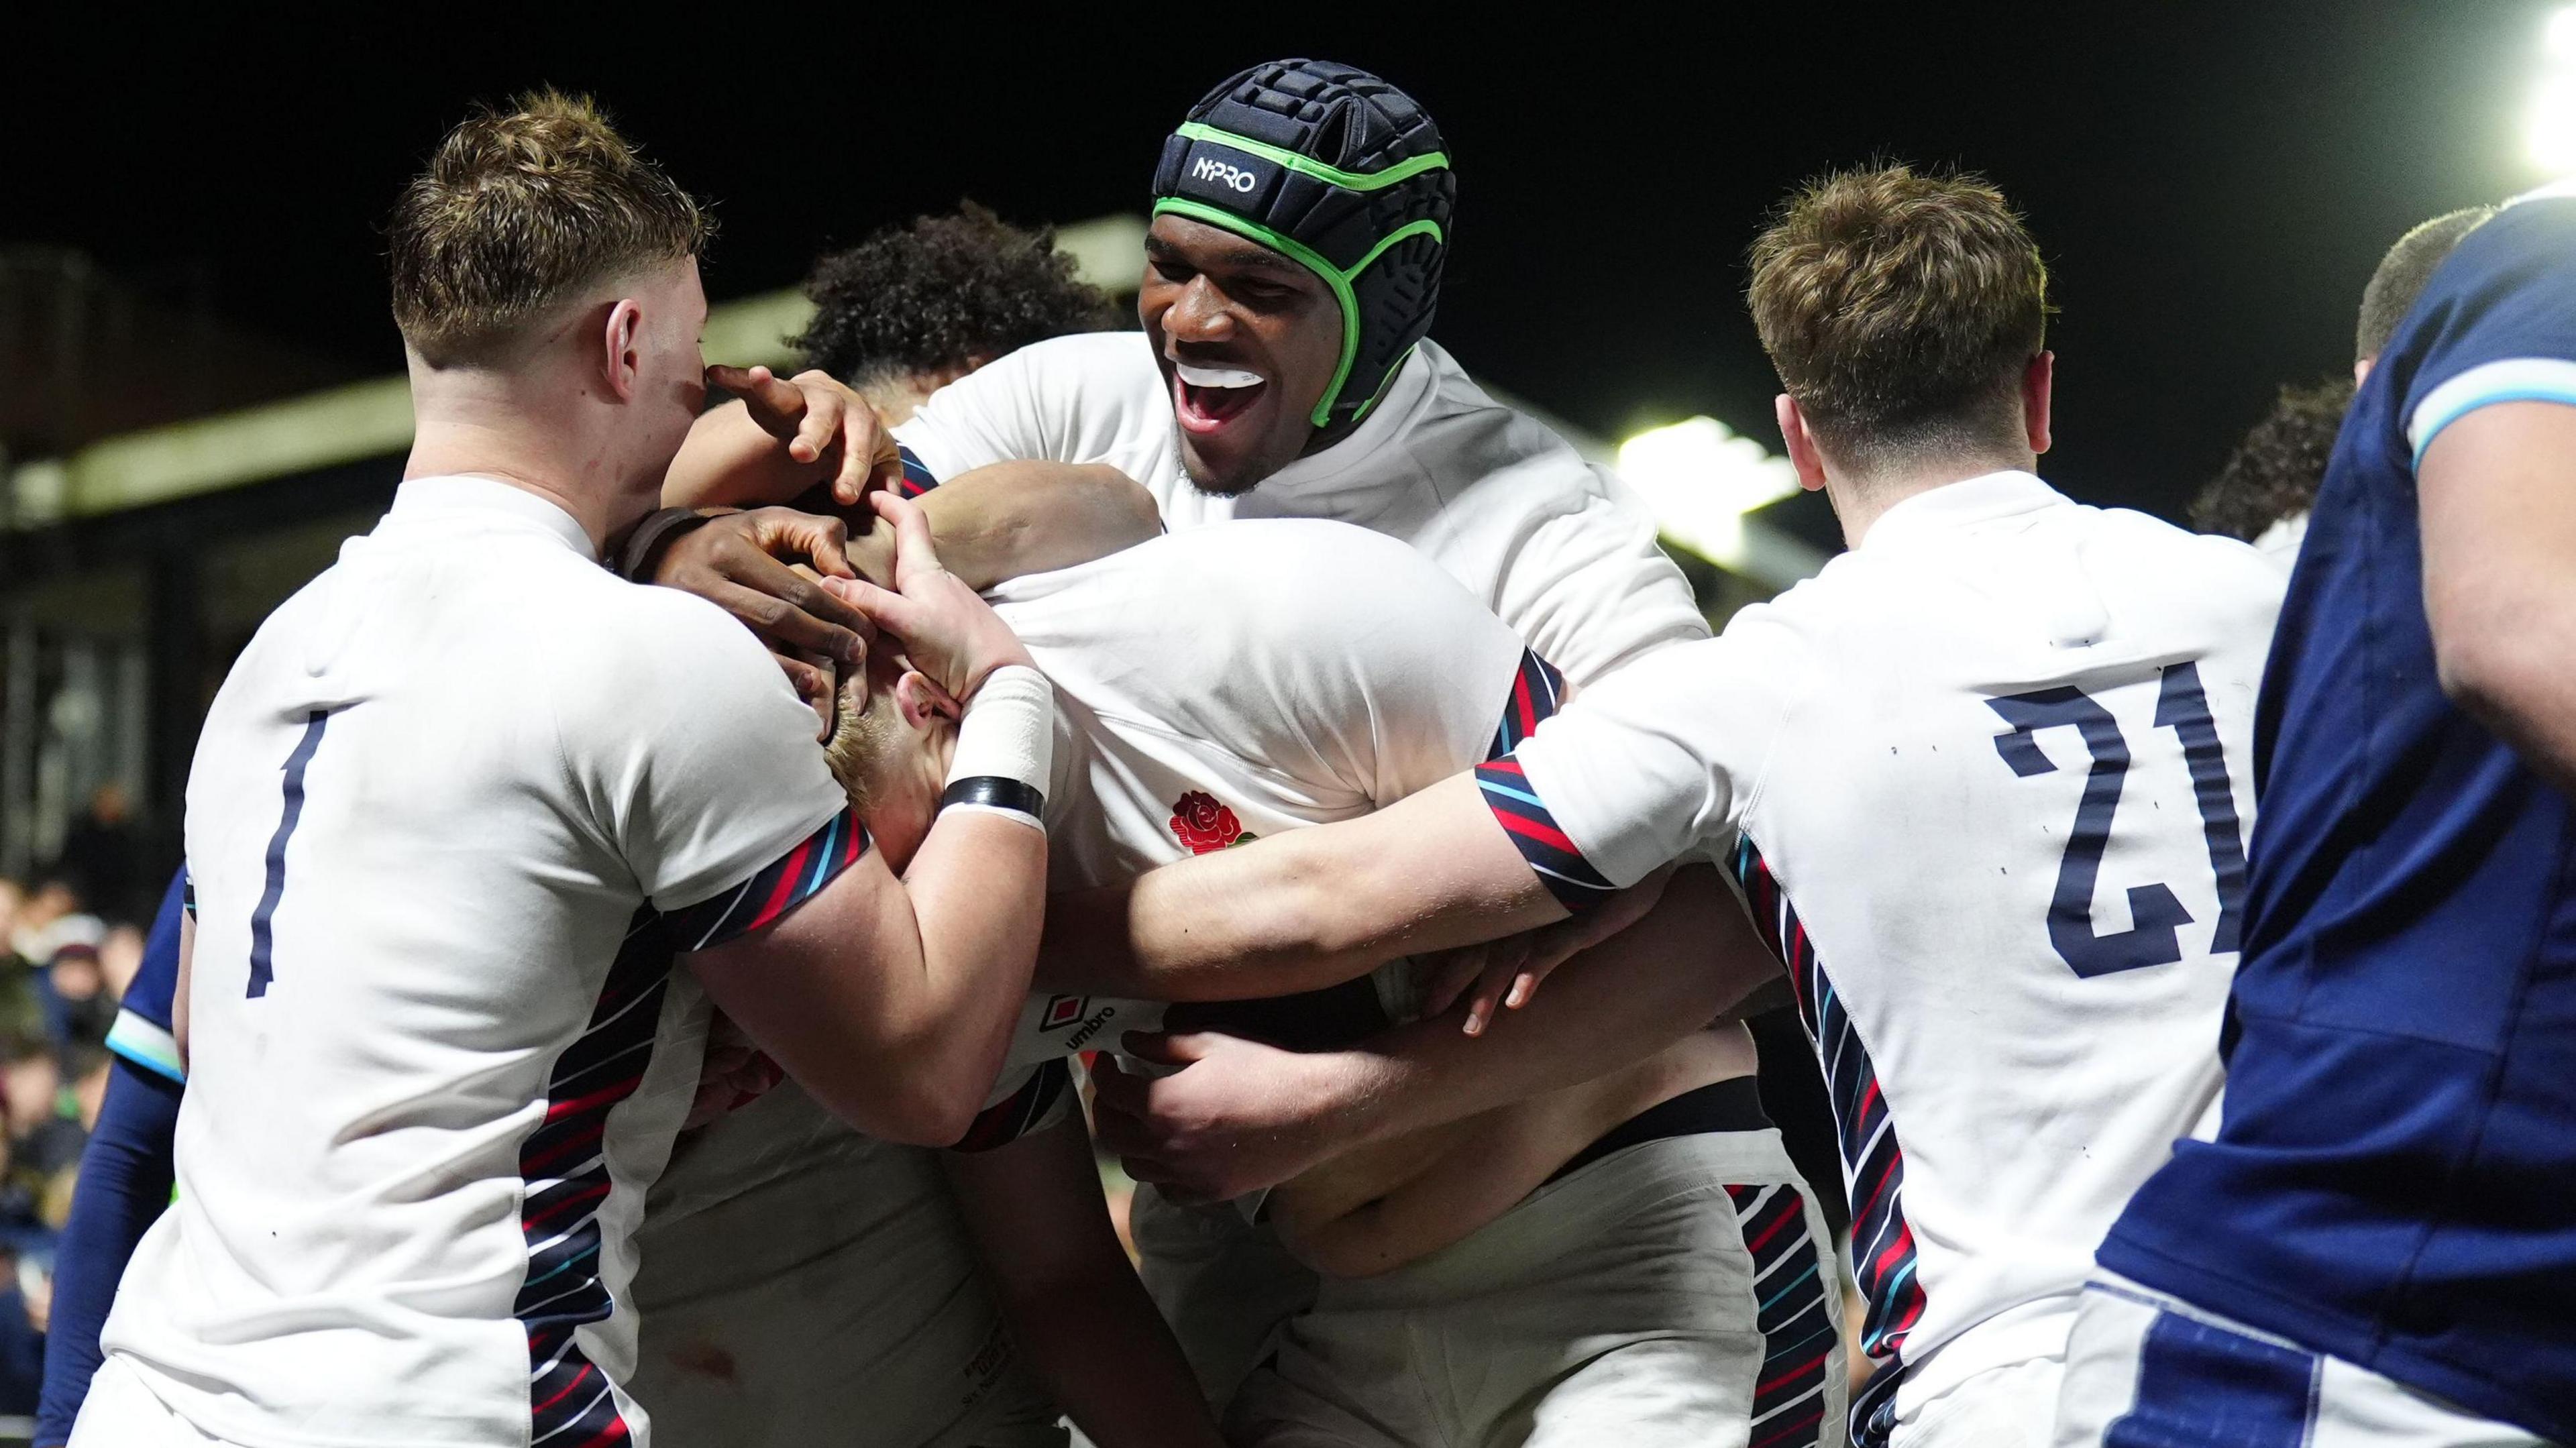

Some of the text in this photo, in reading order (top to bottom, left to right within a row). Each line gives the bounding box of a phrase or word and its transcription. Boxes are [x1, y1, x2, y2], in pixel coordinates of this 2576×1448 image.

[246, 710, 329, 999] 1
[1984, 661, 2249, 979] 21
[1065, 1007, 1115, 1050] umbro
